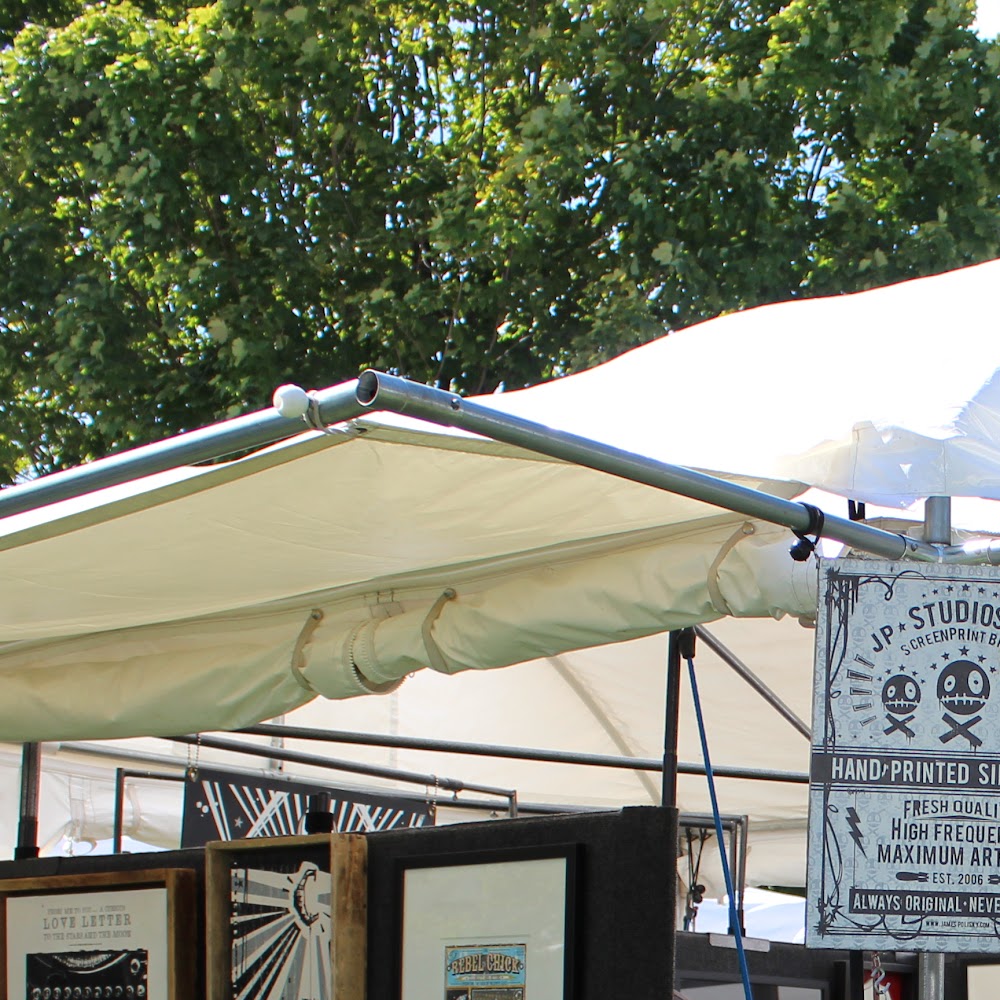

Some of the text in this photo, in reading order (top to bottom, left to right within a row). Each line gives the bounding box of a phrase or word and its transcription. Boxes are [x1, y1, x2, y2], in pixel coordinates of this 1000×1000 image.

[870, 624, 894, 653] JP
[900, 627, 986, 656] SCREENPRINT
[903, 799, 948, 820] FRESH
[891, 817, 929, 841] HIGH
[877, 844, 964, 866] MAXIMUM
[932, 873, 983, 886] EST. 2006
[853, 893, 900, 911] ALWAYS
[905, 895, 962, 913] ORIGINAL
[43, 913, 132, 930] LOVE LETTER
[451, 953, 520, 974] REBEL CHICK
